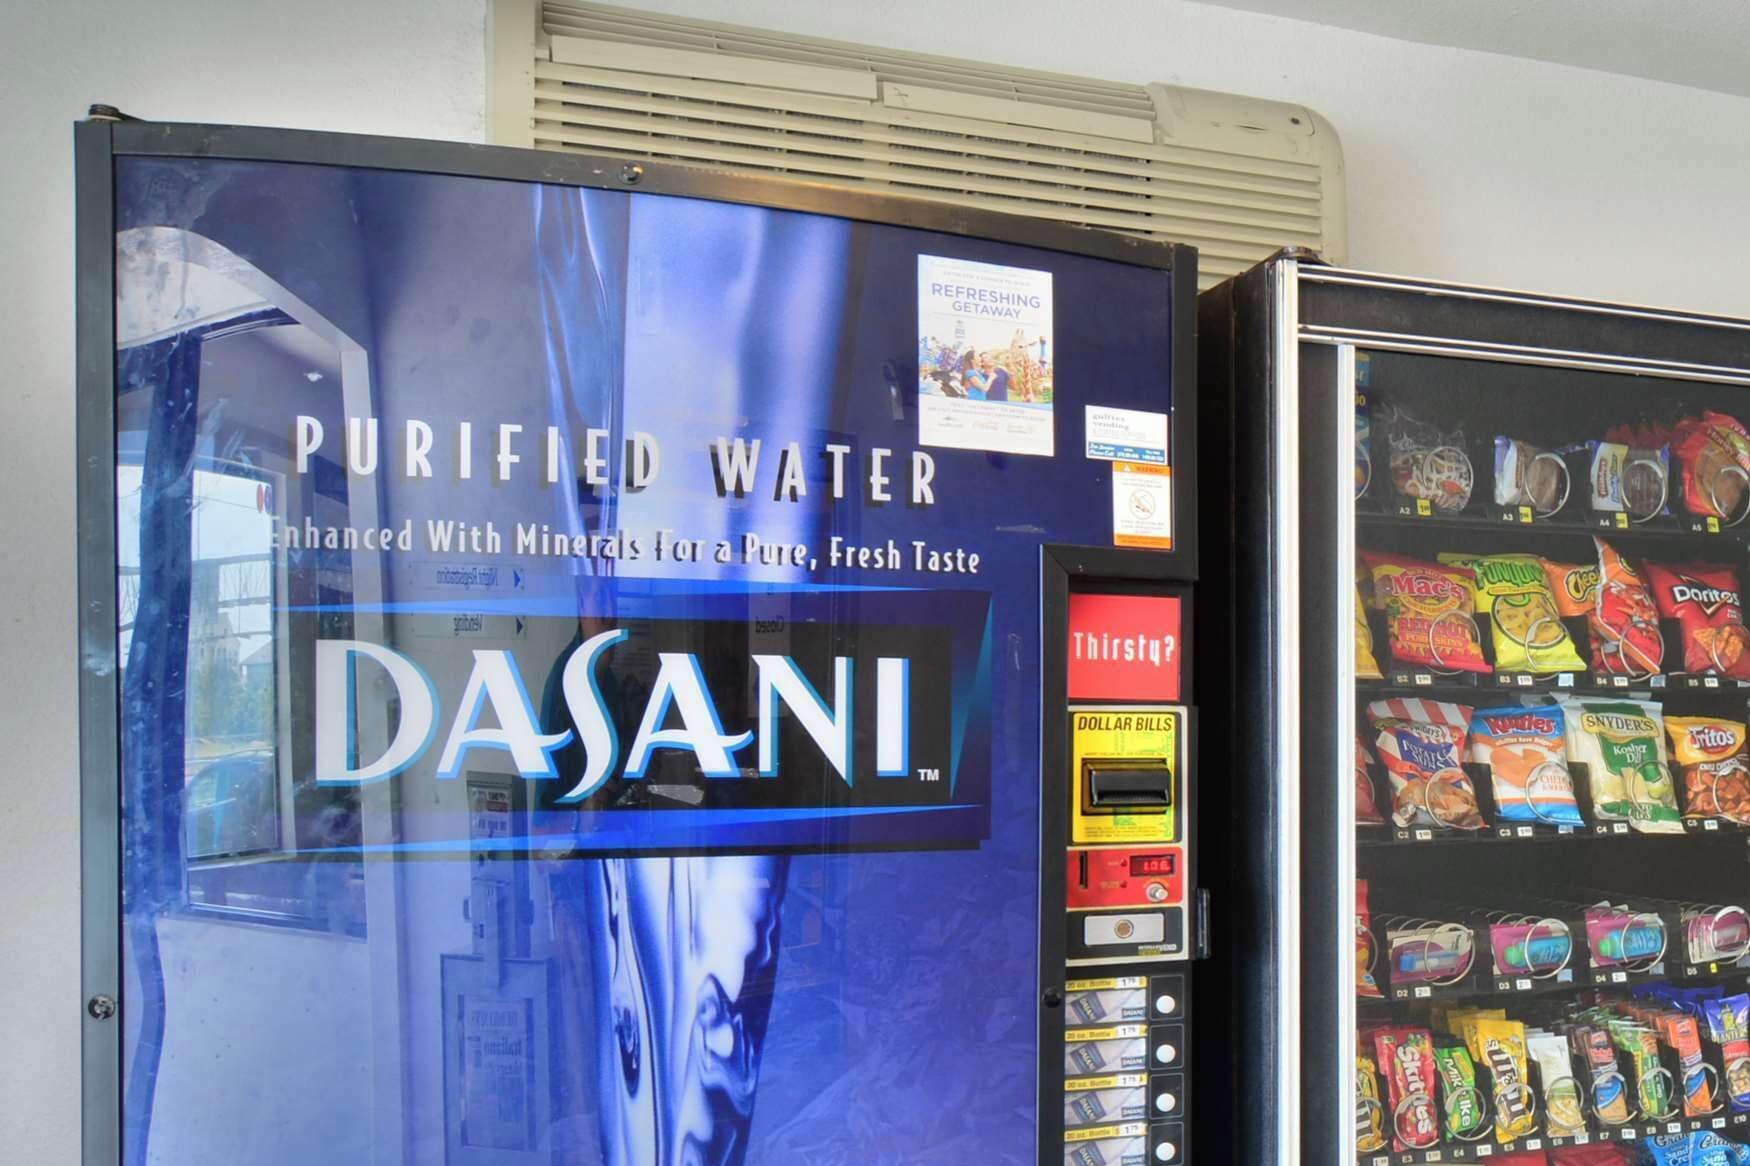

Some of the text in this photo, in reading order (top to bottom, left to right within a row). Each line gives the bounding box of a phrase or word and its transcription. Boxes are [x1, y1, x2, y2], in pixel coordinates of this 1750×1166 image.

[931, 282, 1041, 309] REFRESHING
[951, 300, 1021, 319] GETAWAY
[295, 414, 937, 505] PURIFIED WATER
[1400, 506, 1411, 515] A2
[1502, 513, 1513, 521] A3
[1599, 519, 1610, 527] A4
[269, 514, 981, 574] Enhanced With Minerals For a Pure, Fresh Taste
[1391, 575, 1465, 601] Mac's
[1672, 585, 1741, 607] Doritos
[1073, 631, 1176, 667] Thirsty?
[315, 628, 910, 804] DASANI
[1077, 715, 1173, 732] DOLLAR BILLS
[1586, 714, 1654, 732] SNYDER'S
[1688, 725, 1737, 750] Fritos
[1613, 742, 1648, 756] Kosher
[1595, 975, 1606, 983] D4
[1687, 967, 1697, 975] D5
[1397, 989, 1408, 997] D2
[1498, 982, 1510, 990] D3
